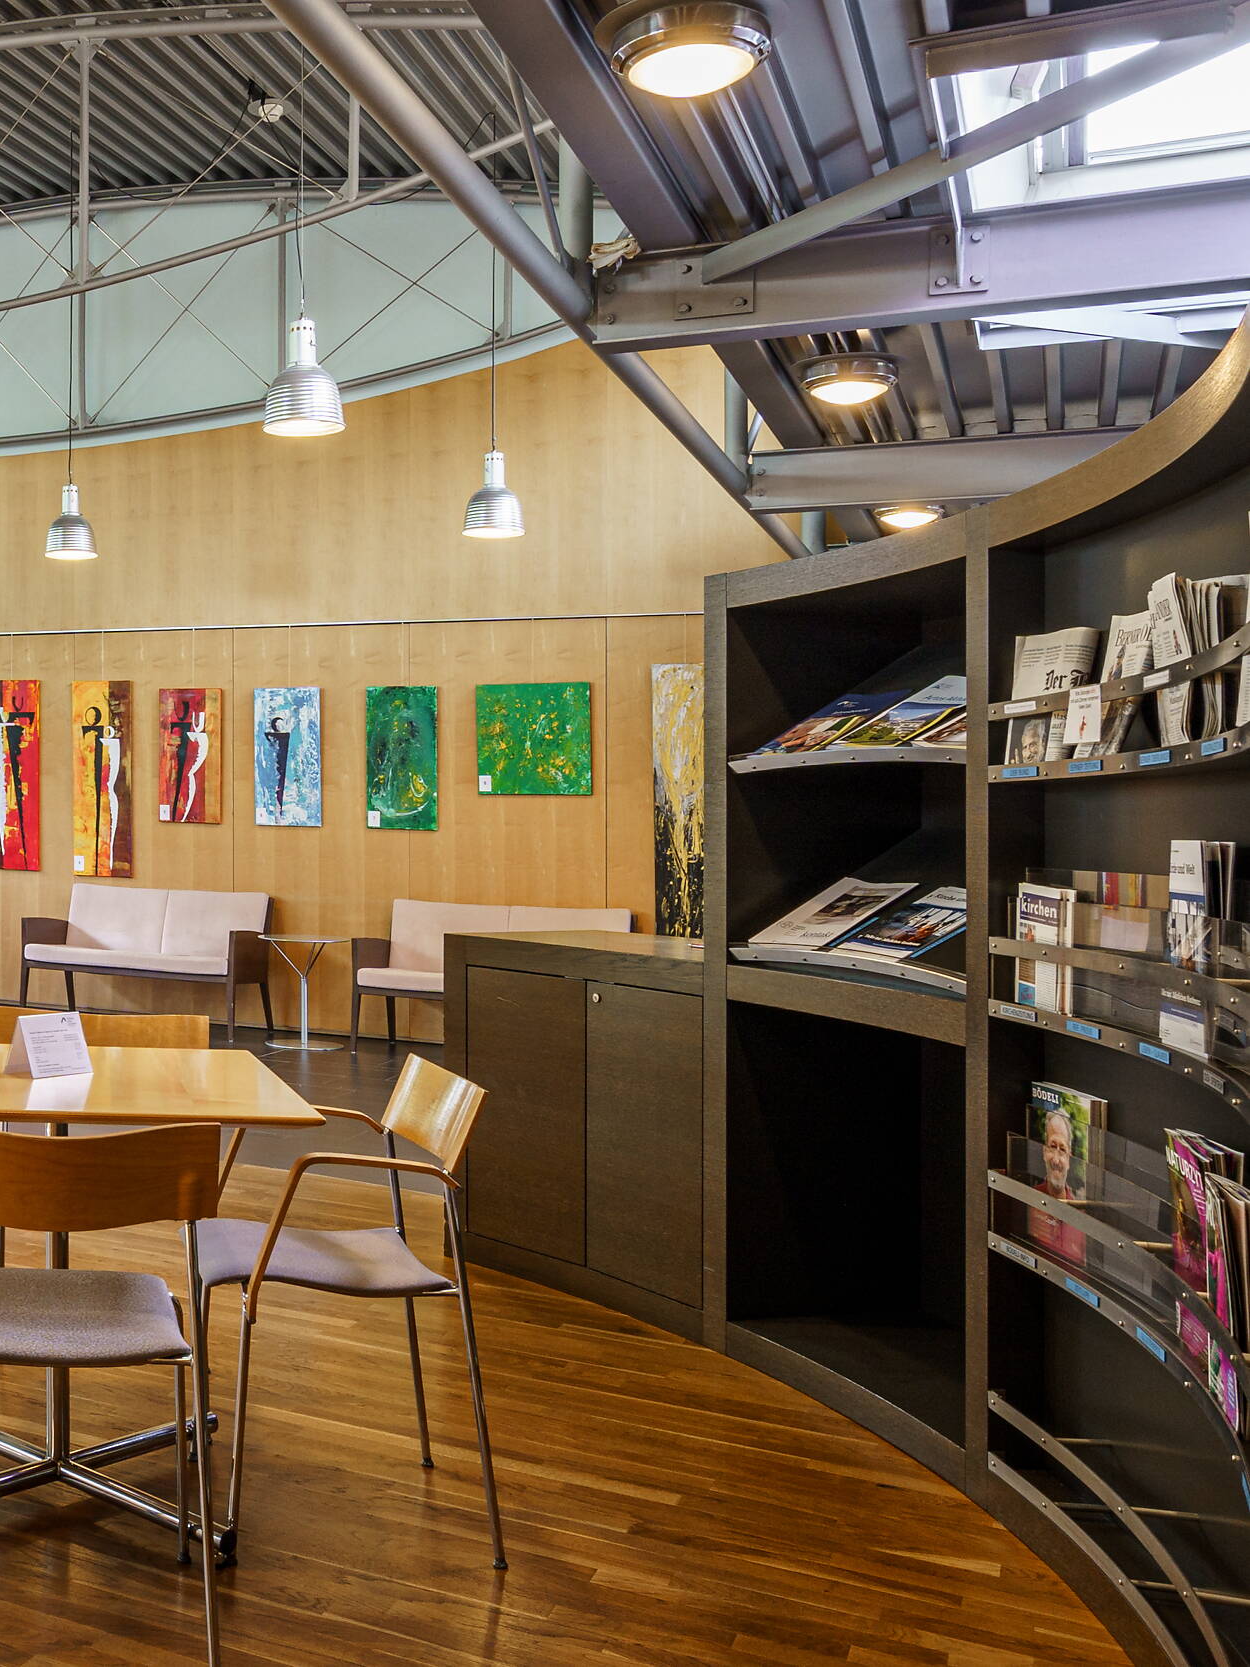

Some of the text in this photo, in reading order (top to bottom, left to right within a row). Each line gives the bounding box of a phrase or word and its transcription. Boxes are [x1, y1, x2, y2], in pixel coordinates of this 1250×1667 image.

[1043, 669, 1069, 690] Der
[1021, 896, 1058, 919] kirchen
[1032, 1086, 1060, 1105] BÖDELI
